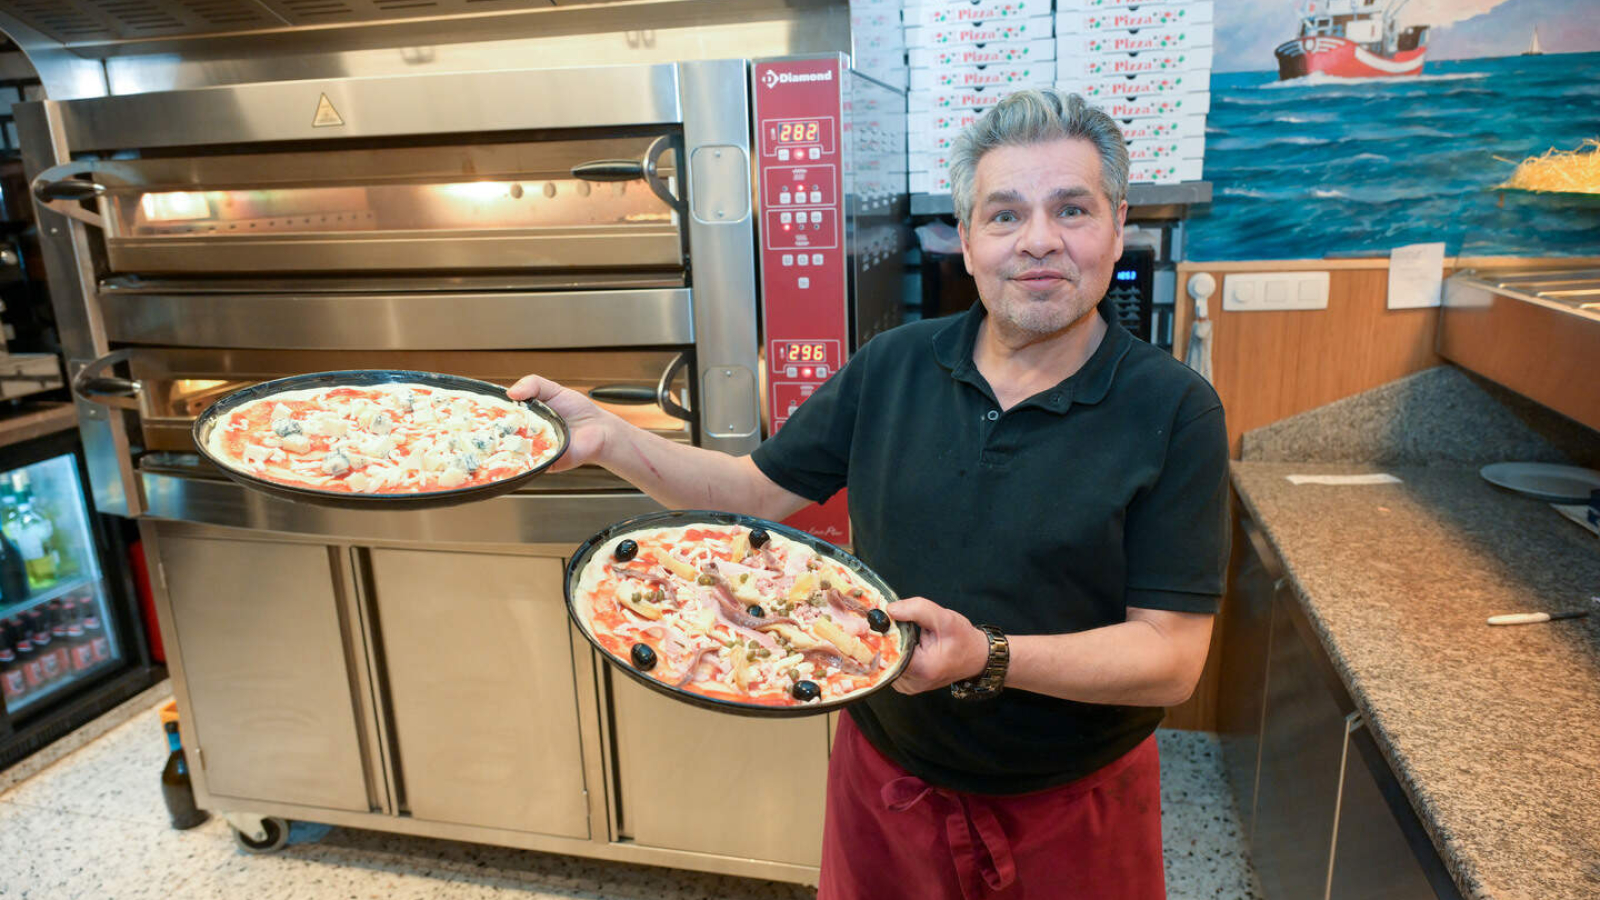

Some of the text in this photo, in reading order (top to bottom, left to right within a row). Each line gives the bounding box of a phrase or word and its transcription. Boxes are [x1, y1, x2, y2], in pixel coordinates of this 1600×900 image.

[959, 8, 995, 20] Pizza
[1114, 15, 1152, 27] Pizza
[960, 30, 996, 41] Pizza
[1114, 38, 1152, 50] Pizza
[963, 51, 999, 63] Pizza
[1114, 60, 1152, 72] Pizza
[779, 69, 833, 83] Diamond
[964, 73, 1000, 85] Pizza
[1112, 83, 1150, 94] Pizza
[962, 95, 997, 106] Pizza
[1112, 104, 1150, 116] Pizza
[780, 123, 818, 141] 282
[788, 344, 824, 361] 296
